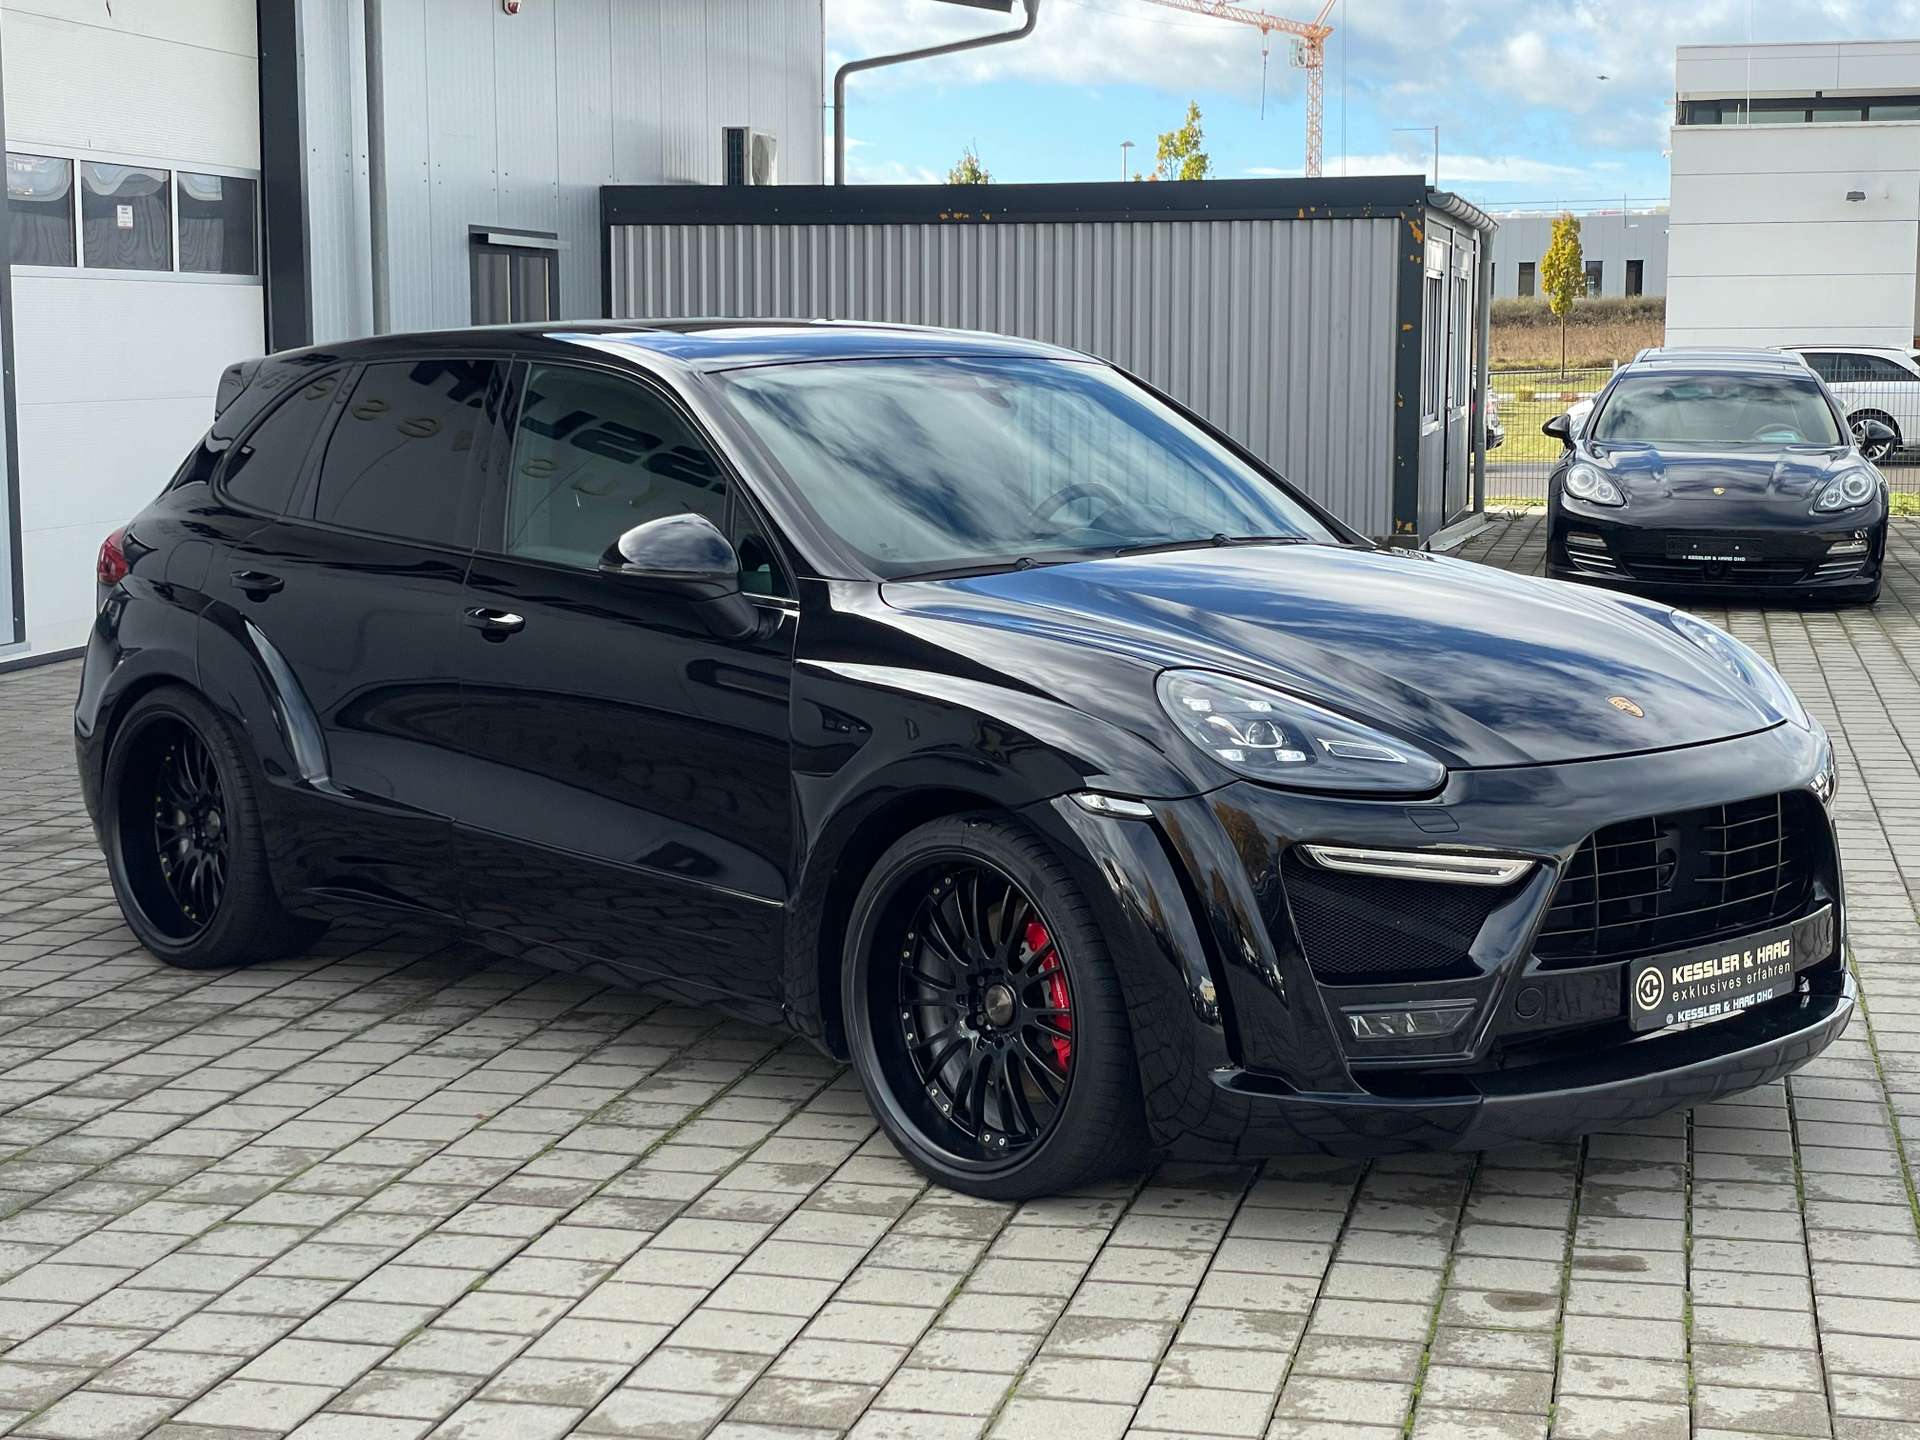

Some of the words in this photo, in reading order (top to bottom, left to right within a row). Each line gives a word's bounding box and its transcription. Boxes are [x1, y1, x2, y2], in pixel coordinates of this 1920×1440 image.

[1672, 953, 1739, 985] KESSLER
[1743, 950, 1754, 968] &
[1757, 939, 1790, 965] HAAG
[1672, 977, 1742, 1001] exklusives
[1747, 962, 1790, 984] erfahren
[1677, 1003, 1721, 1022] KESSLER
[1723, 1001, 1732, 1012] &
[1733, 993, 1755, 1010] HAAG
[1757, 988, 1773, 1004] OHG
